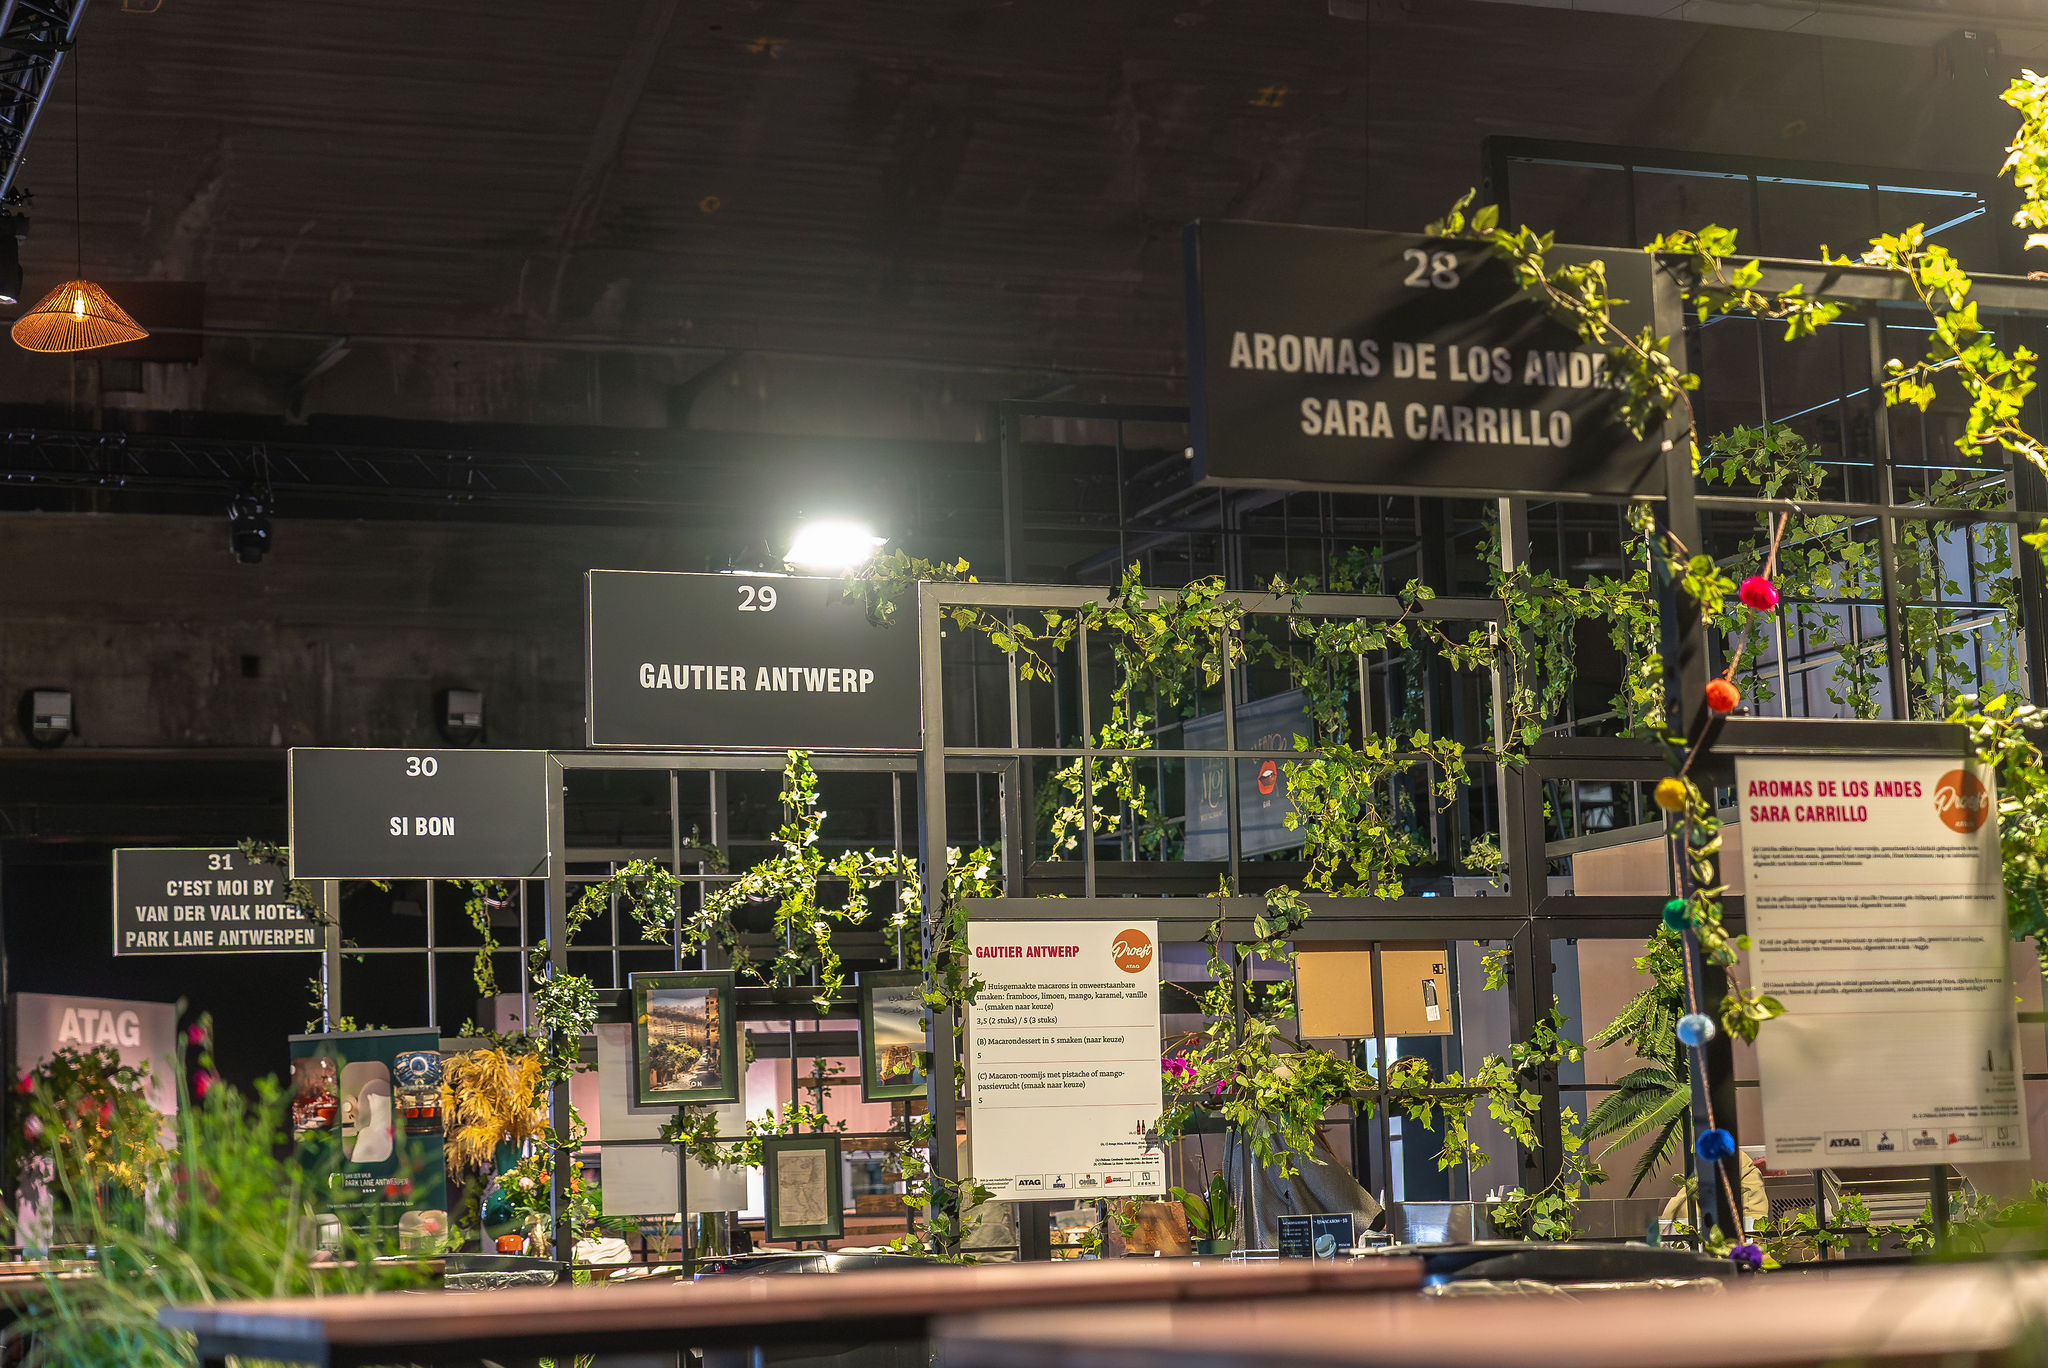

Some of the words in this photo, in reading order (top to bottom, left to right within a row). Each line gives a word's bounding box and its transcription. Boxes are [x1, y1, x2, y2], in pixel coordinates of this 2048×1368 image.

[1403, 248, 1459, 290] 28
[1229, 331, 1380, 377] AROMAS
[1393, 342, 1437, 380] DE
[1449, 344, 1512, 385] LOS
[1301, 397, 1394, 439] SARA
[1405, 402, 1572, 448] CARRILLO
[737, 585, 777, 612] 29
[639, 662, 747, 691] GAUTIER
[755, 666, 875, 693] ANTWERP
[405, 756, 438, 777] 30
[1748, 780, 1813, 798] AROMAS
[1818, 780, 1837, 797] DE
[1842, 780, 1869, 797] LOS
[1874, 780, 1922, 797] ANDES
[1750, 805, 1790, 822] SARA
[1795, 805, 1868, 822] CARRILLO
[389, 816, 408, 836] SI
[415, 816, 455, 836] BON
[207, 853, 234, 871] 31
[166, 879, 213, 897] C'EST
[217, 880, 248, 896] MOI
[253, 879, 274, 896] BY
[136, 905, 168, 922] VAN
[173, 905, 205, 922] DER
[210, 904, 250, 921] VALK
[125, 930, 169, 948] PARK
[173, 929, 213, 947] LANE
[217, 928, 316, 947] ANTWERPEN
[975, 946, 1023, 958] GAUTIER
[1026, 945, 1080, 958] ANTWERP
[1112, 940, 1152, 961] Proeft
[988, 982, 1036, 991] Huisgemaakte
[1079, 981, 1136, 989] onweerstaanbare
[1006, 992, 1040, 1001] framboos,
[1041, 992, 1067, 1001] limoen,
[1068, 993, 1094, 1001] mango,
[1095, 991, 1124, 1000] karamel,
[1125, 991, 1148, 999] vanille
[984, 1003, 1014, 1012] (smaken
[1031, 1003, 1054, 1011] keuze)
[58, 1007, 140, 1048] ATAG
[976, 1017, 988, 1025] 3,5
[988, 1017, 996, 1025] (2
[997, 1016, 1018, 1025] stuks)
[1029, 1017, 1036, 1025] (3
[1037, 1016, 1058, 1024] stuks)
[976, 1038, 987, 1046] (B)
[988, 1037, 1041, 1045] Macarondessert
[1083, 1035, 1101, 1044] (naar
[1102, 1035, 1125, 1043] keuze)
[977, 1072, 987, 1081] (C)
[988, 1071, 1046, 1080] Macaron-roomijs
[1047, 1071, 1061, 1079] met
[1062, 1070, 1090, 1080] pistache
[1099, 1071, 1125, 1079] mango-
[978, 1082, 1020, 1091] passievrucht
[1021, 1081, 1045, 1090] (smaak
[1063, 1081, 1086, 1089] keuze)
[1829, 1138, 1860, 1148] ATAG
[1018, 1178, 1041, 1186] ATAG
